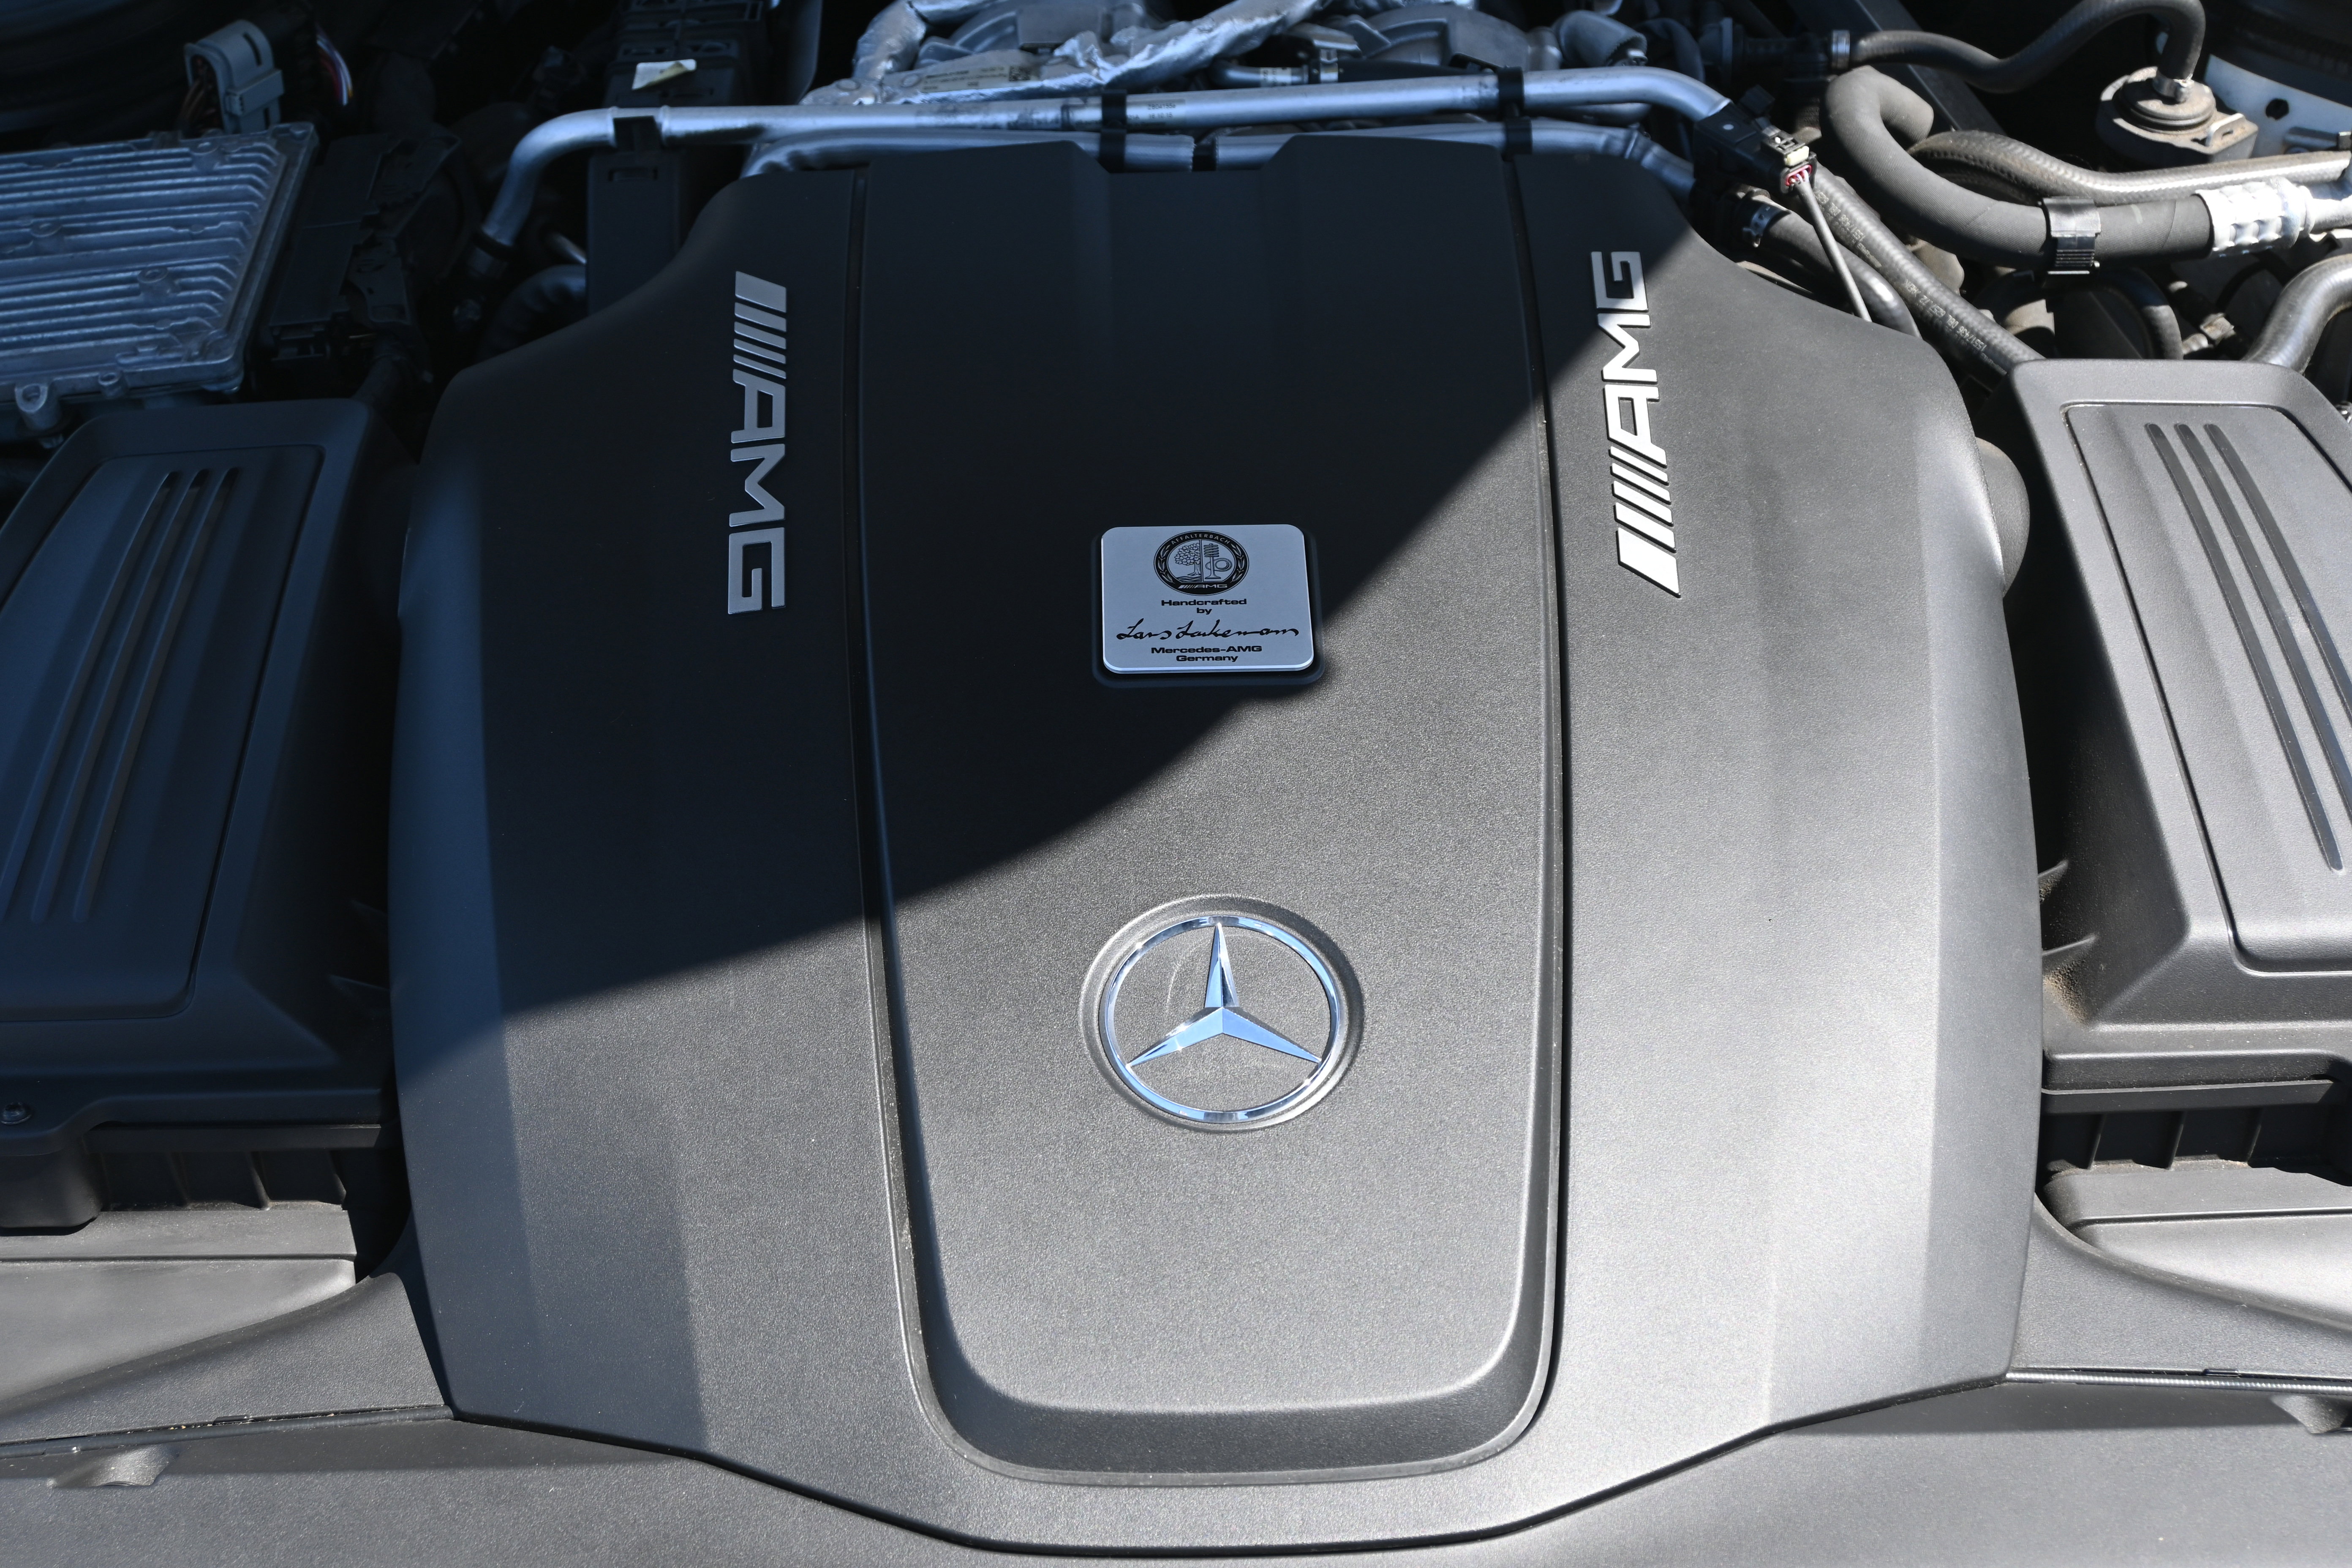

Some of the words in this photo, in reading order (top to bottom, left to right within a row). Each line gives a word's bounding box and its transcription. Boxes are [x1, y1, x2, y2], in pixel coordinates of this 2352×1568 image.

[1946, 315, 1959, 329] DBL
[1957, 326, 1987, 351] 15517436
[1171, 534, 1230, 545] AFFALTERBACH
[1151, 645, 1262, 653] Mercedes-AMG
